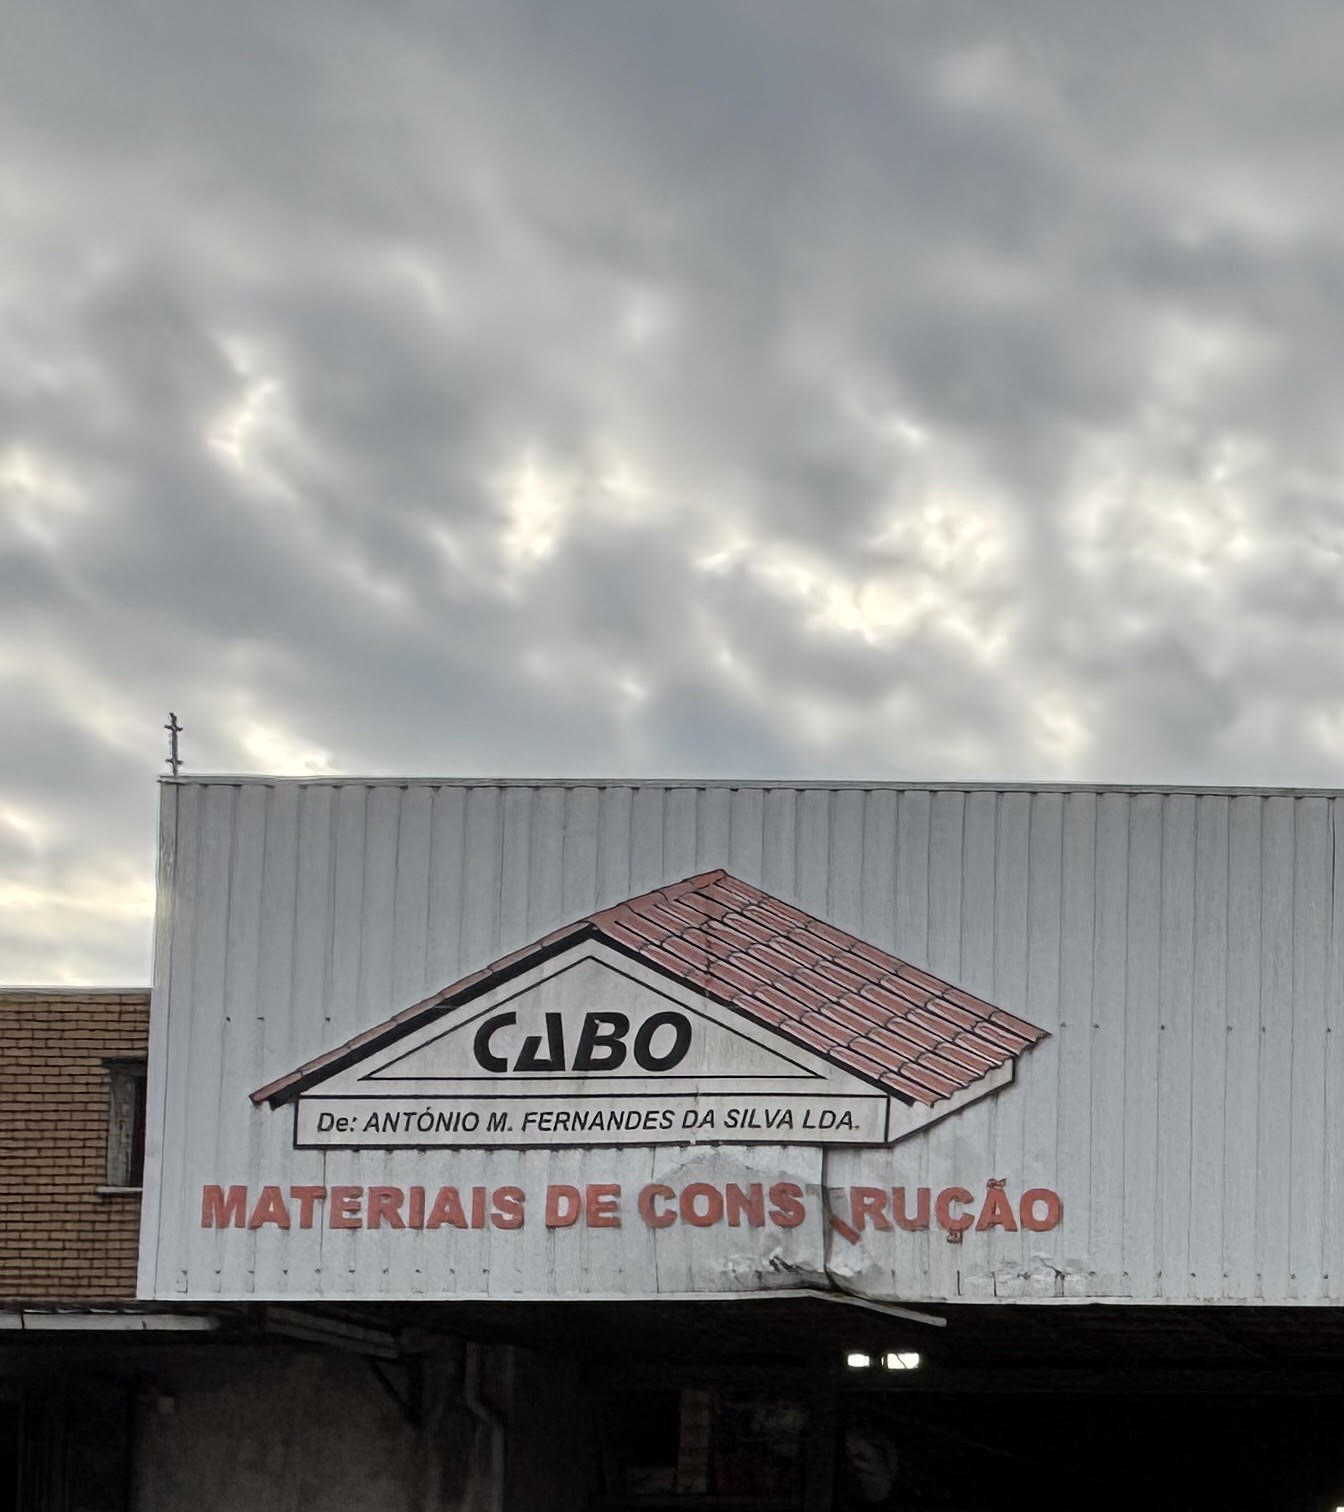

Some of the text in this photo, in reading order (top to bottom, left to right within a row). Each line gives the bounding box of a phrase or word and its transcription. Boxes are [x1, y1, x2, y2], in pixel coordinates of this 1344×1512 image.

[473, 1010, 692, 1073] CABO
[316, 1106, 862, 1133] De: ANTÓNIO M. FERNANDES DA SILVA LDA.
[199, 1177, 1064, 1244] MATERIAIS DE CONSRUÇÃO
